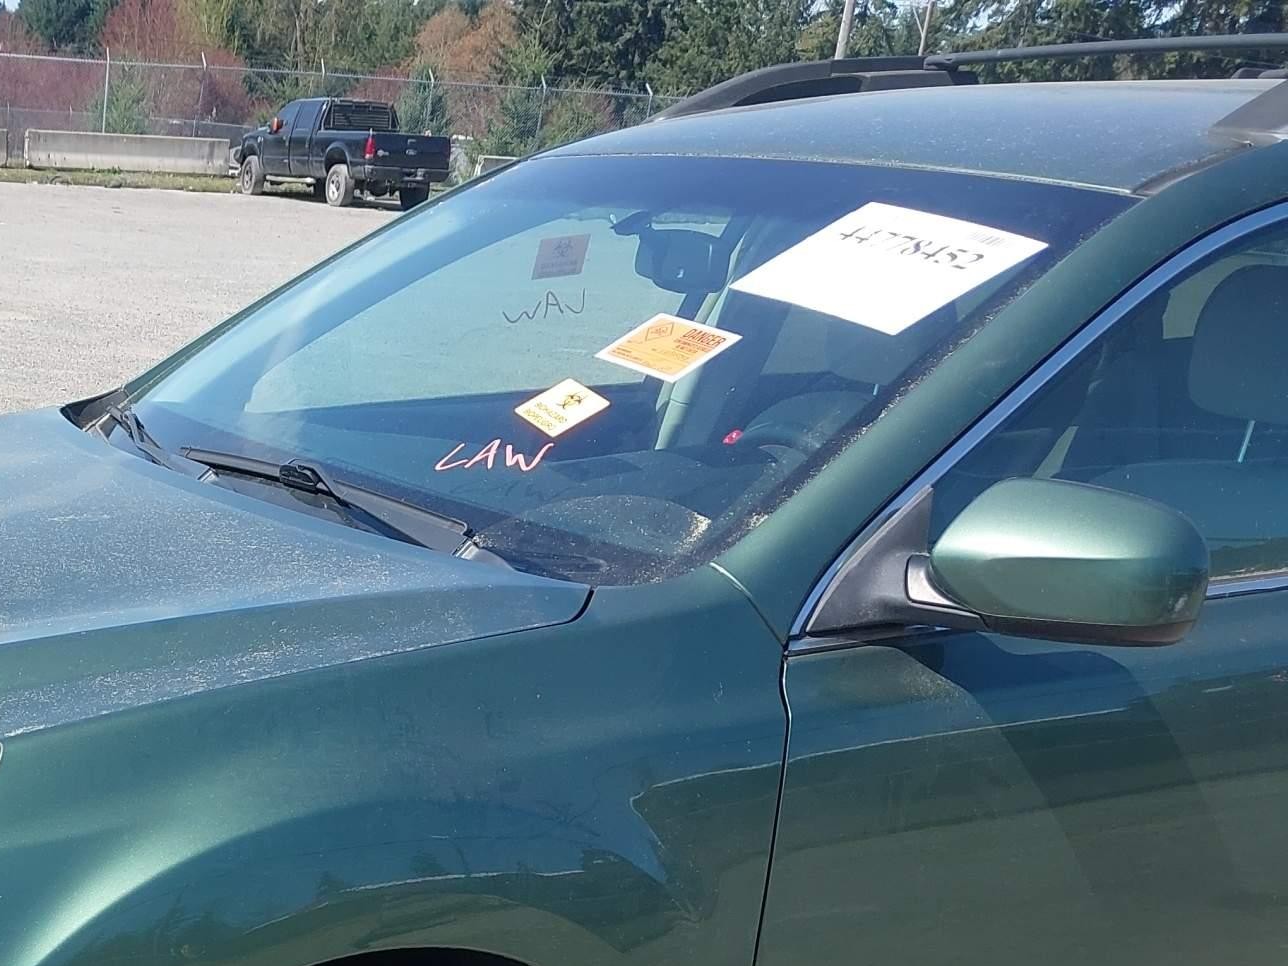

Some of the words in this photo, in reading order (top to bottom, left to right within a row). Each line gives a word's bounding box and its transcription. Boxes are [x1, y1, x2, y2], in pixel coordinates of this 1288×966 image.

[839, 226, 985, 270] 44778452
[682, 327, 727, 348] DANGER
[434, 438, 554, 471] LAW
